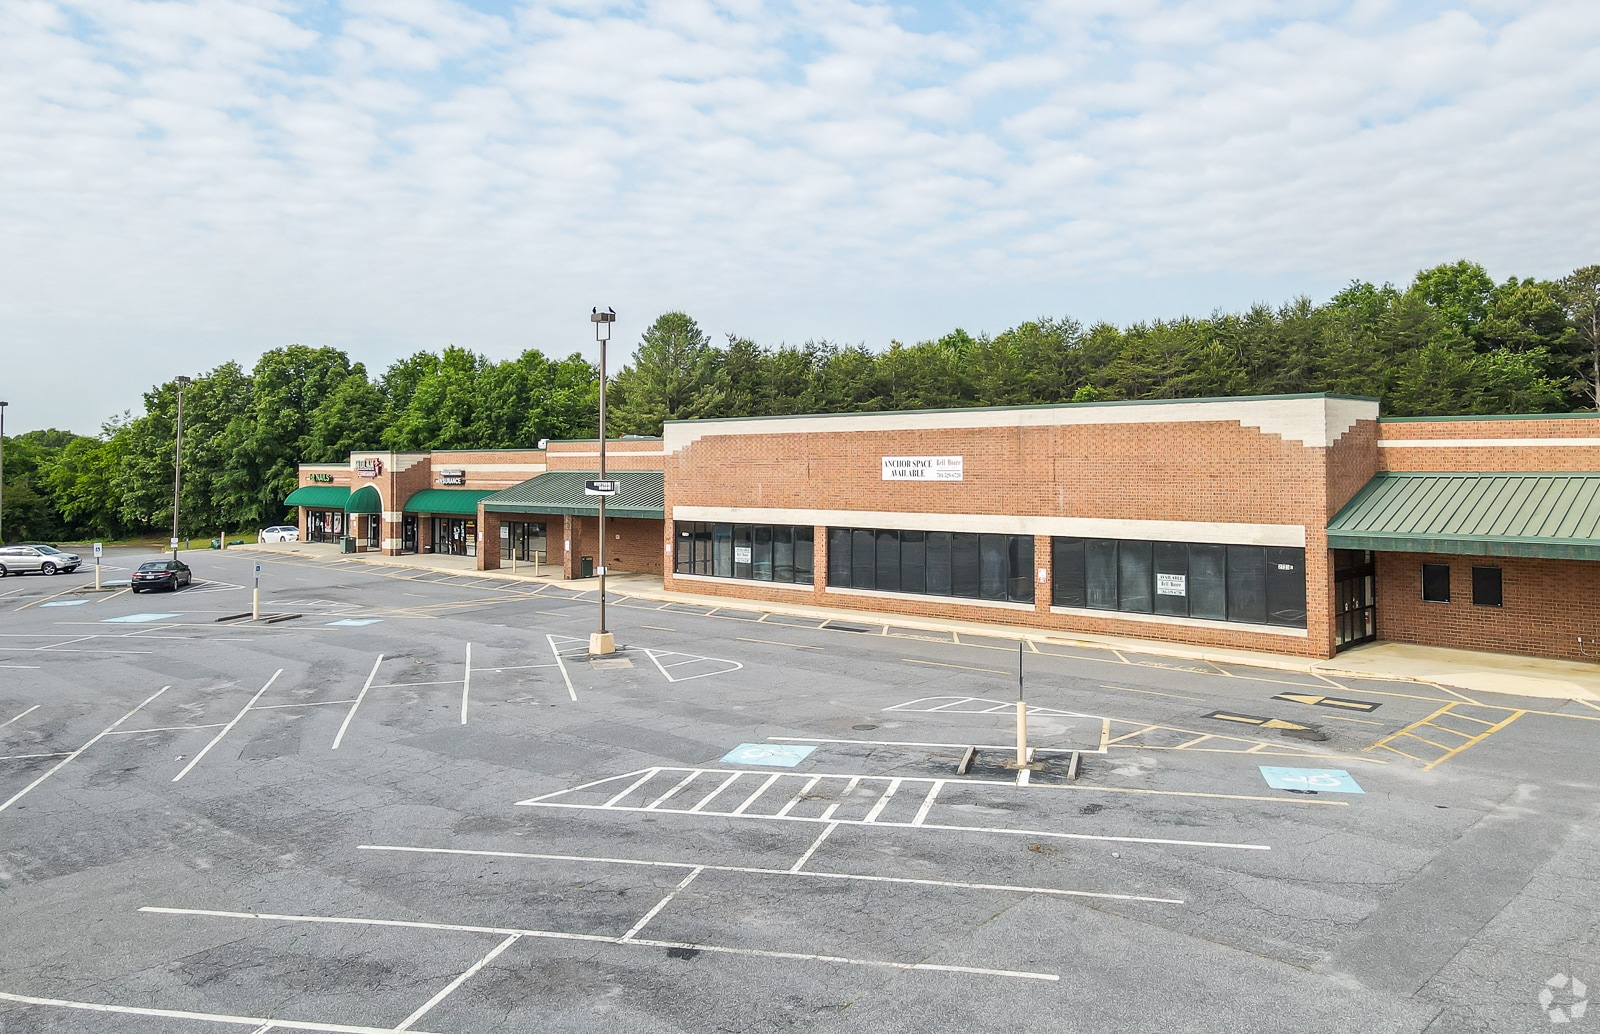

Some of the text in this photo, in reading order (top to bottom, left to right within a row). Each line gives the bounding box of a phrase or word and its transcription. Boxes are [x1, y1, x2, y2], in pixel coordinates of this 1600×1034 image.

[884, 459, 933, 468] ANCHOR SPACE
[891, 469, 925, 477] AVAILABLE
[316, 474, 331, 482] NAILS
